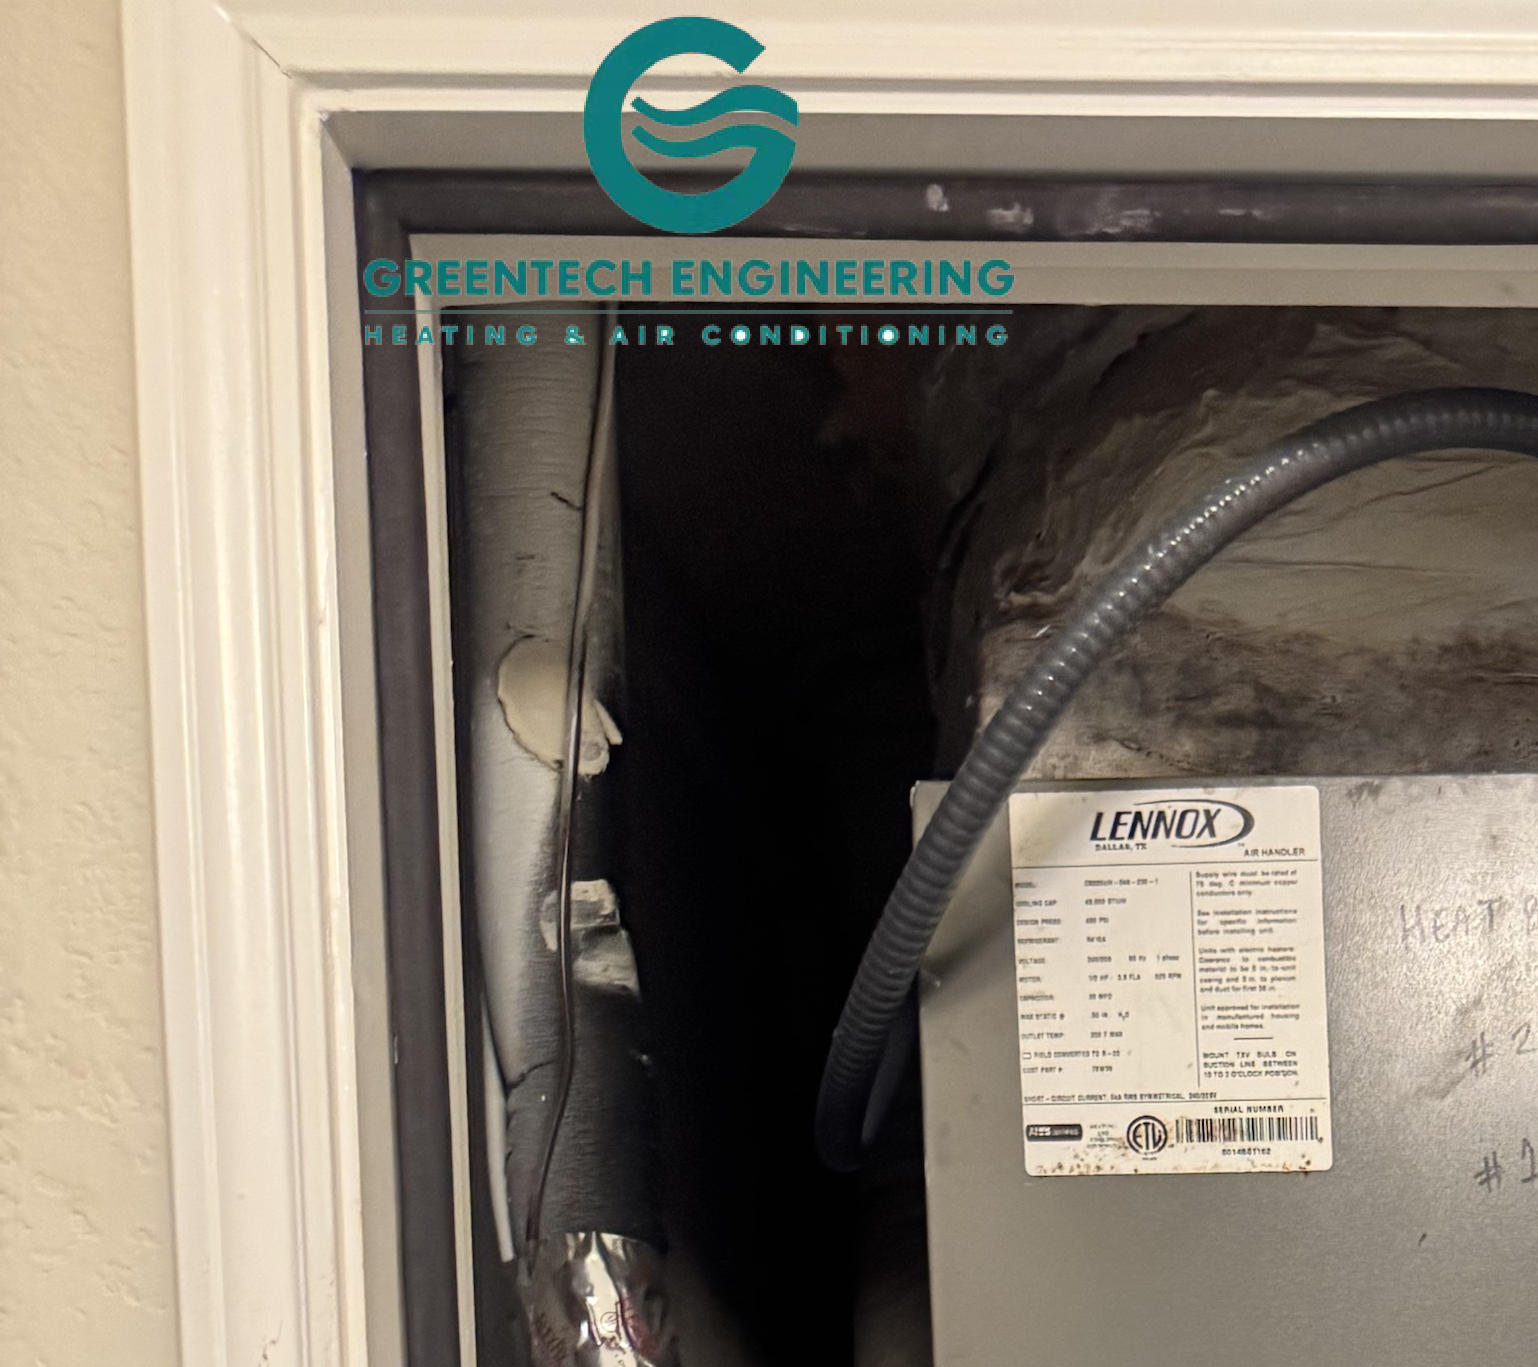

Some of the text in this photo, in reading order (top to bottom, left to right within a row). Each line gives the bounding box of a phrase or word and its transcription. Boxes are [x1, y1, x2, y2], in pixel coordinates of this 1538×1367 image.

[1090, 808, 1221, 841] LENNOX
[1243, 847, 1304, 856] AIR HANDLER
[1400, 896, 1503, 947] HEAT
